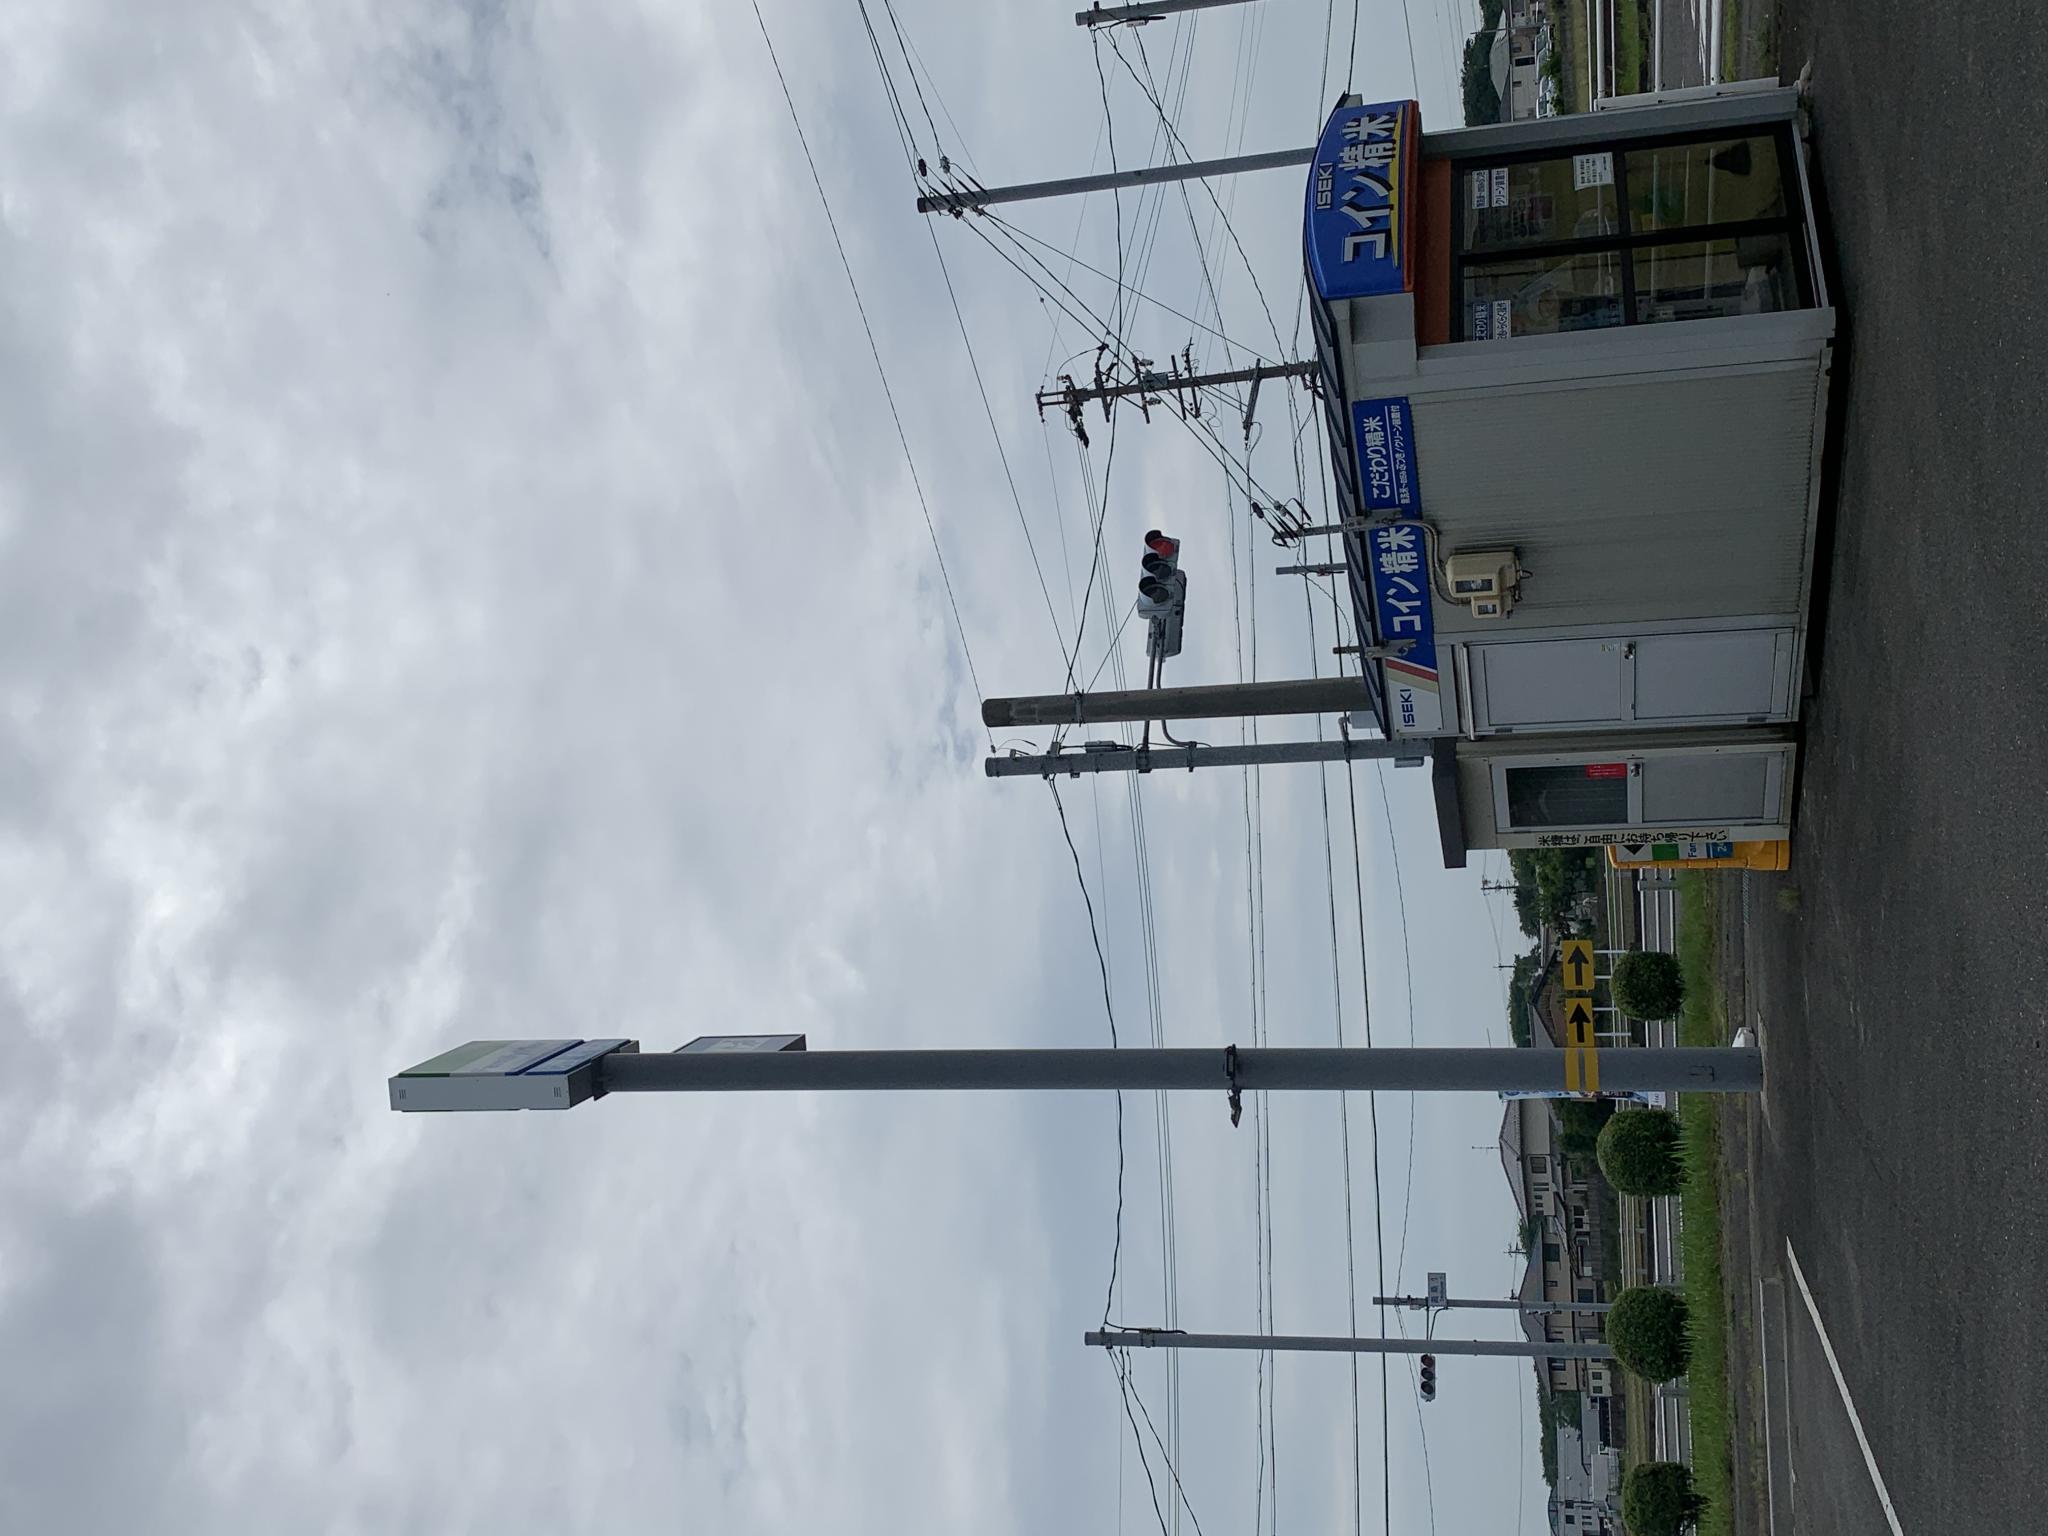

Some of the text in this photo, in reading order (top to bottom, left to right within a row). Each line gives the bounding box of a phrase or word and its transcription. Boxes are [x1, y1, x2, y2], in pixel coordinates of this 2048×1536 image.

[1315, 161, 1334, 210] ISEKI
[1337, 114, 1395, 262] コイン精米
[1363, 416, 1390, 499] こだわり精米
[1377, 526, 1422, 632] コイン精米
[1399, 688, 1416, 728] ISEKI
